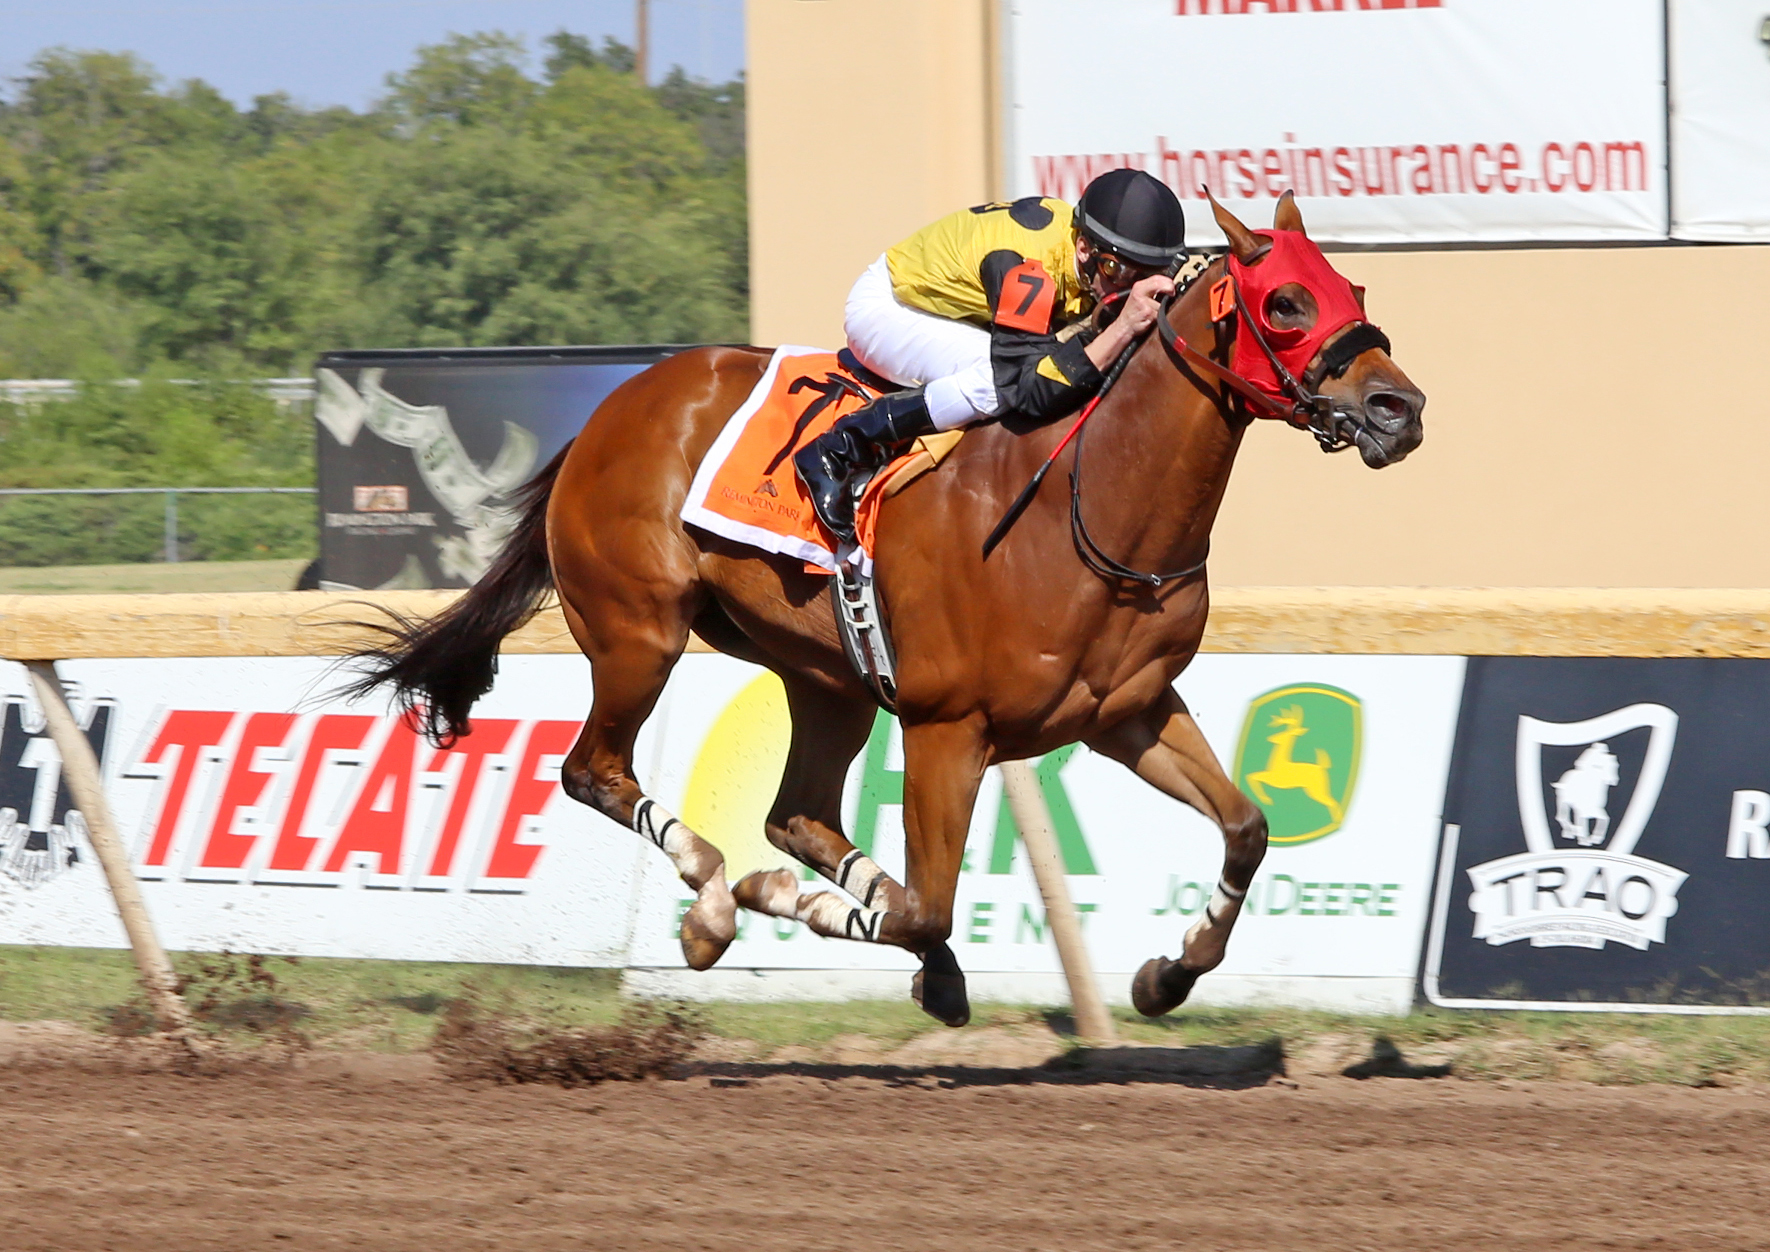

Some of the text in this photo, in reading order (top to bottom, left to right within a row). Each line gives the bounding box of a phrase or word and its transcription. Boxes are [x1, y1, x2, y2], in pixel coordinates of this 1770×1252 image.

[1031, 134, 1649, 201] wwhorseinsurance.com
[1014, 273, 1044, 316] 7
[1213, 279, 1228, 314] 7
[763, 375, 846, 475] 7
[778, 504, 800, 521] PAR
[144, 705, 586, 878] TECATE
[1725, 789, 1770, 860] R
[1266, 873, 1403, 917] DEERE
[1491, 866, 1656, 920] TRAO
